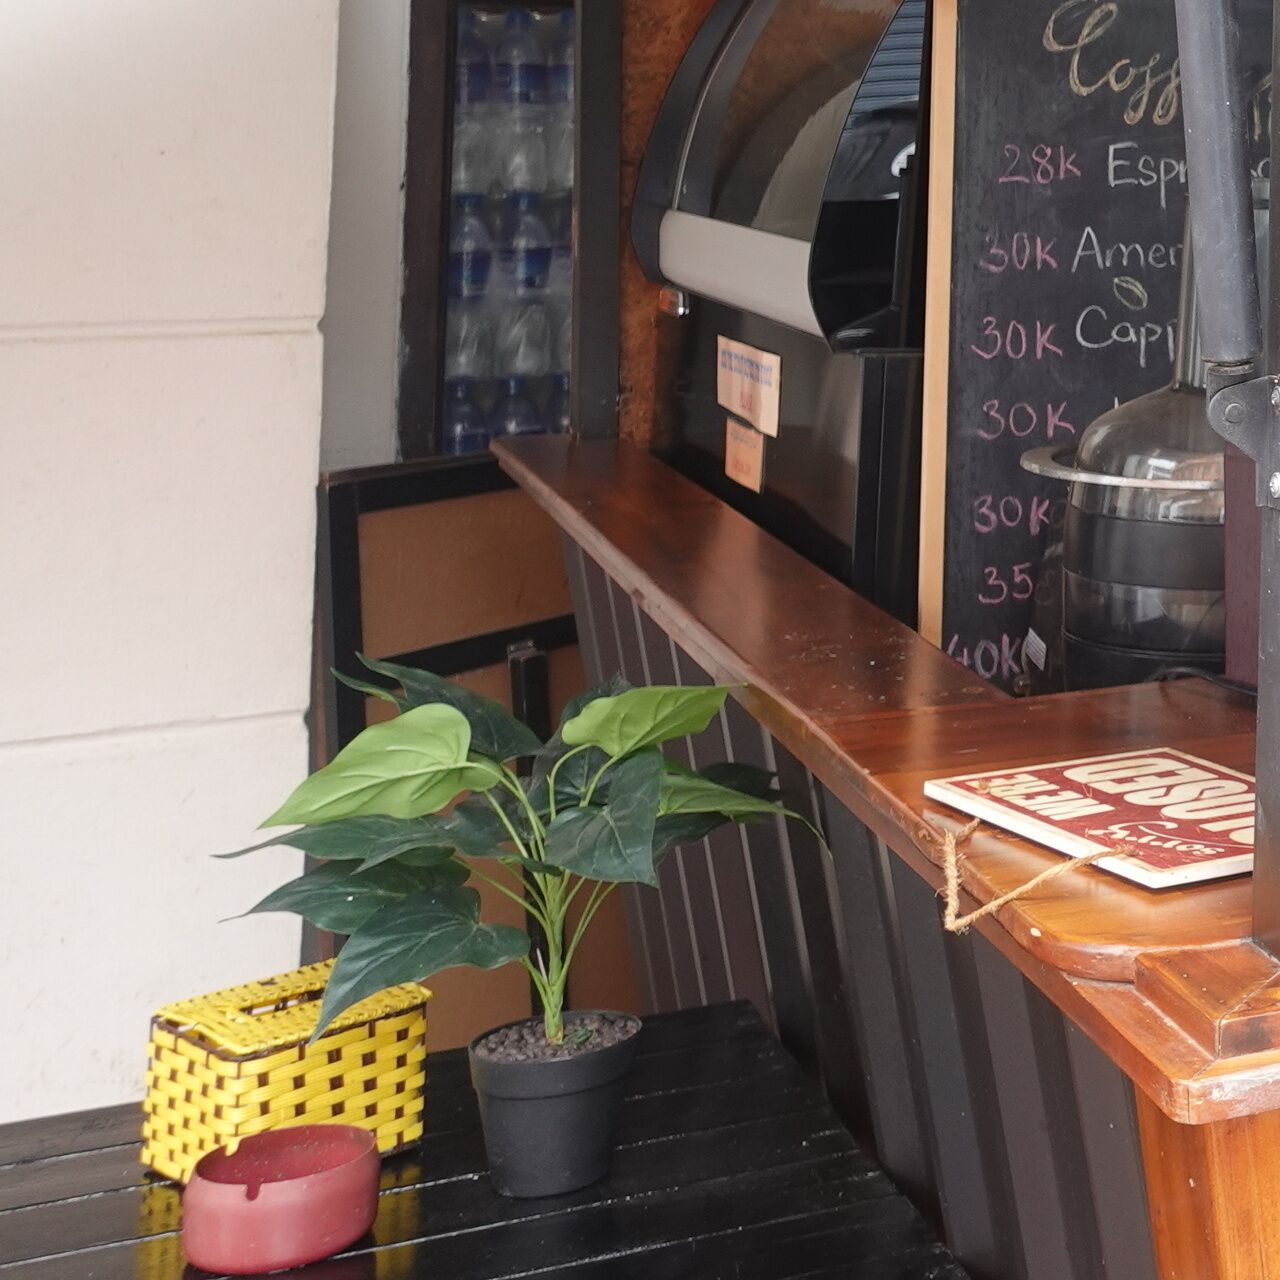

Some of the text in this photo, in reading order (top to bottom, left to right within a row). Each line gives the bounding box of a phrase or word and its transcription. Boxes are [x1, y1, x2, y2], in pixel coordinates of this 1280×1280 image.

[979, 226, 1184, 274] 30K Amer
[971, 317, 1063, 360] 30K
[976, 400, 1076, 441] 30K
[974, 495, 1050, 537] 30K
